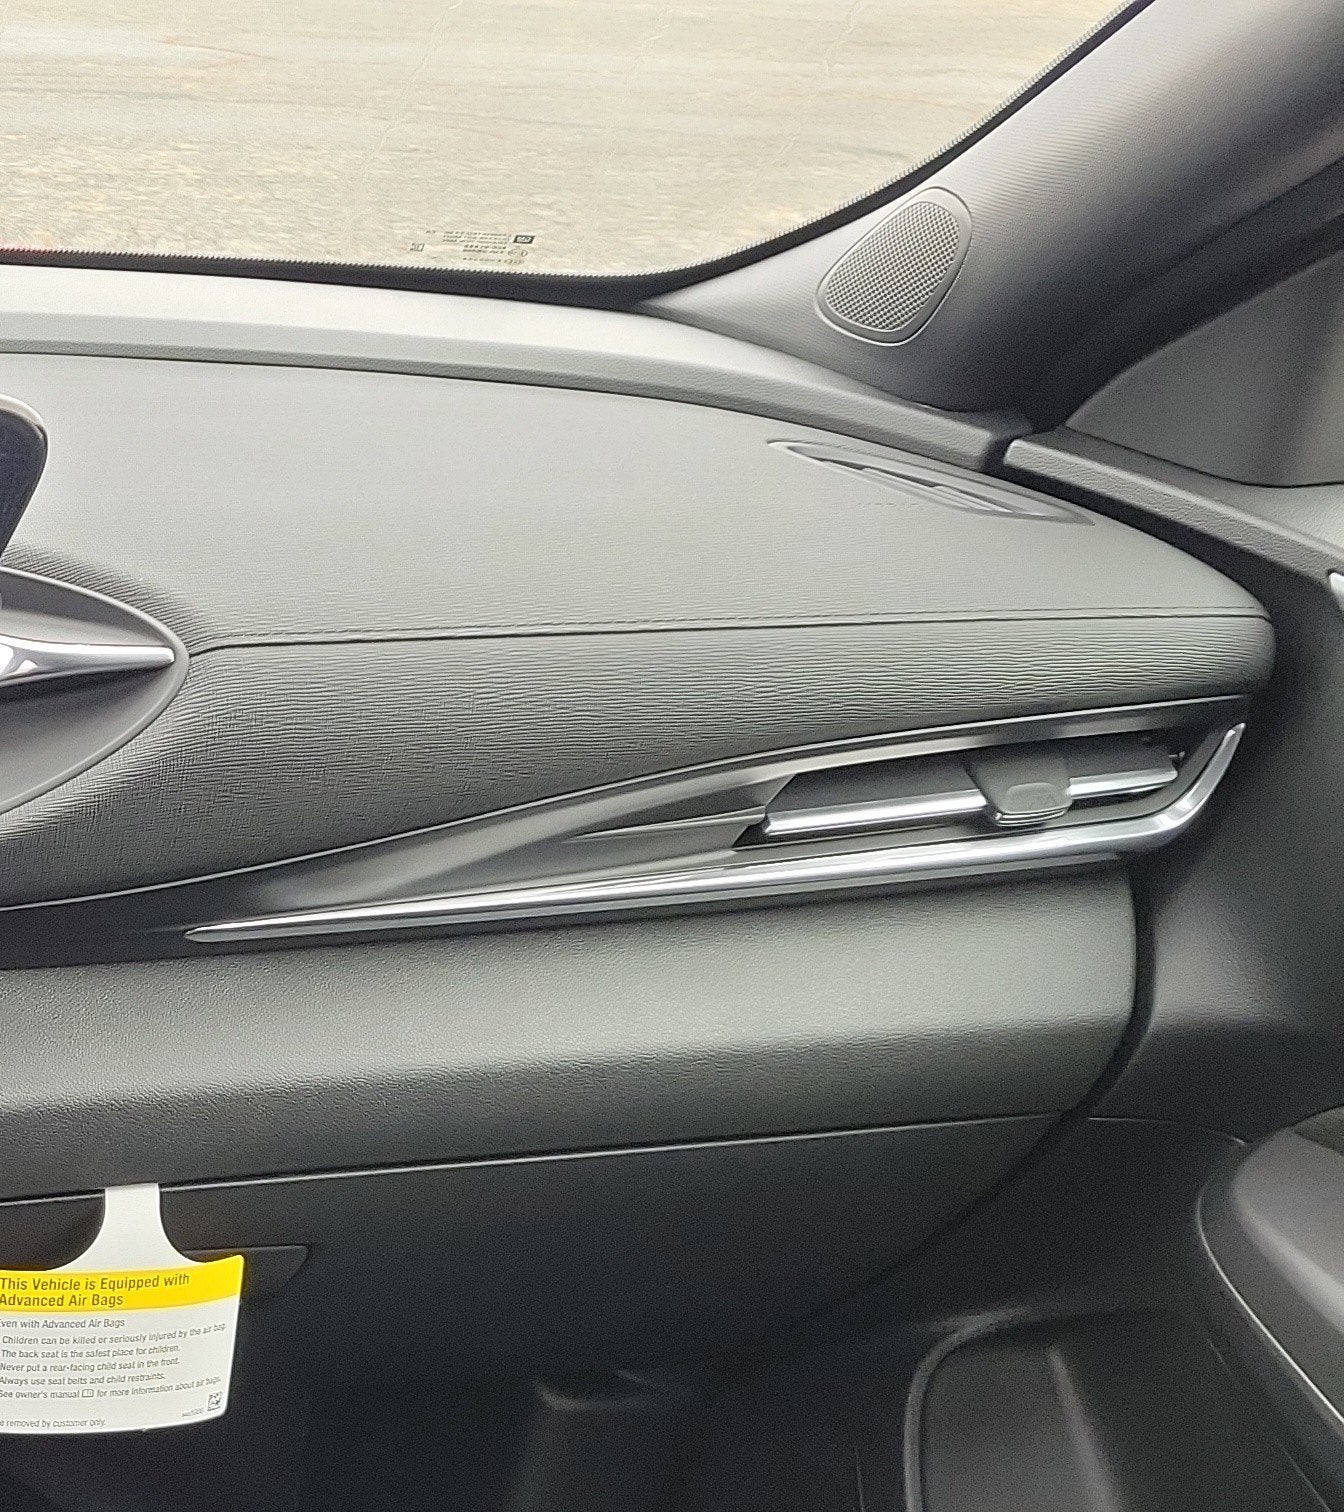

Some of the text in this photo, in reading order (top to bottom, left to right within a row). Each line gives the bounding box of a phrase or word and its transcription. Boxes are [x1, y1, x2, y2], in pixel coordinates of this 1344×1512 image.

[0, 1273, 190, 1292] This Vehicle is Equipped with
[68, 1293, 87, 1307] Air
[91, 1293, 124, 1309] Bags
[20, 1319, 40, 1329] with
[41, 1319, 87, 1329] Advanced
[88, 1318, 101, 1328] Air
[103, 1318, 126, 1329] Bags
[2, 1335, 39, 1345] Children
[40, 1337, 57, 1345] can
[59, 1336, 70, 1344] be
[72, 1335, 96, 1344] killed
[98, 1336, 107, 1344] or
[109, 1333, 147, 1344] seriously
[148, 1330, 177, 1343] injured
[178, 1330, 188, 1340] by
[189, 1327, 201, 1336] the
[1, 1349, 17, 1358] The
[18, 1349, 39, 1358] back
[41, 1350, 59, 1358] seat
[61, 1350, 68, 1358] is
[70, 1349, 84, 1358] the
[85, 1349, 110, 1358] safest
[112, 1347, 134, 1358] place
[135, 1346, 147, 1356] for
[0, 1362, 24, 1372] Never
[26, 1363, 40, 1373] put
[49, 1363, 96, 1373] rear-facing
[96, 1362, 116, 1371] child
[118, 1361, 136, 1370] seat
[137, 1360, 144, 1368] in
[146, 1359, 159, 1367] the
[30, 1377, 46, 1385] use
[48, 1376, 66, 1385] seat
[67, 1376, 87, 1385] belts
[89, 1375, 105, 1385] and
[106, 1374, 126, 1384] child
[15, 1390, 48, 1399] owner's
[50, 1389, 80, 1398] manual
[96, 1389, 107, 1398] for
[109, 1388, 129, 1397] more
[131, 1384, 173, 1395] information
[174, 1381, 194, 1391] about
[6, 1418, 40, 1428] removed
[41, 1418, 52, 1428] by
[52, 1418, 88, 1428] customer
